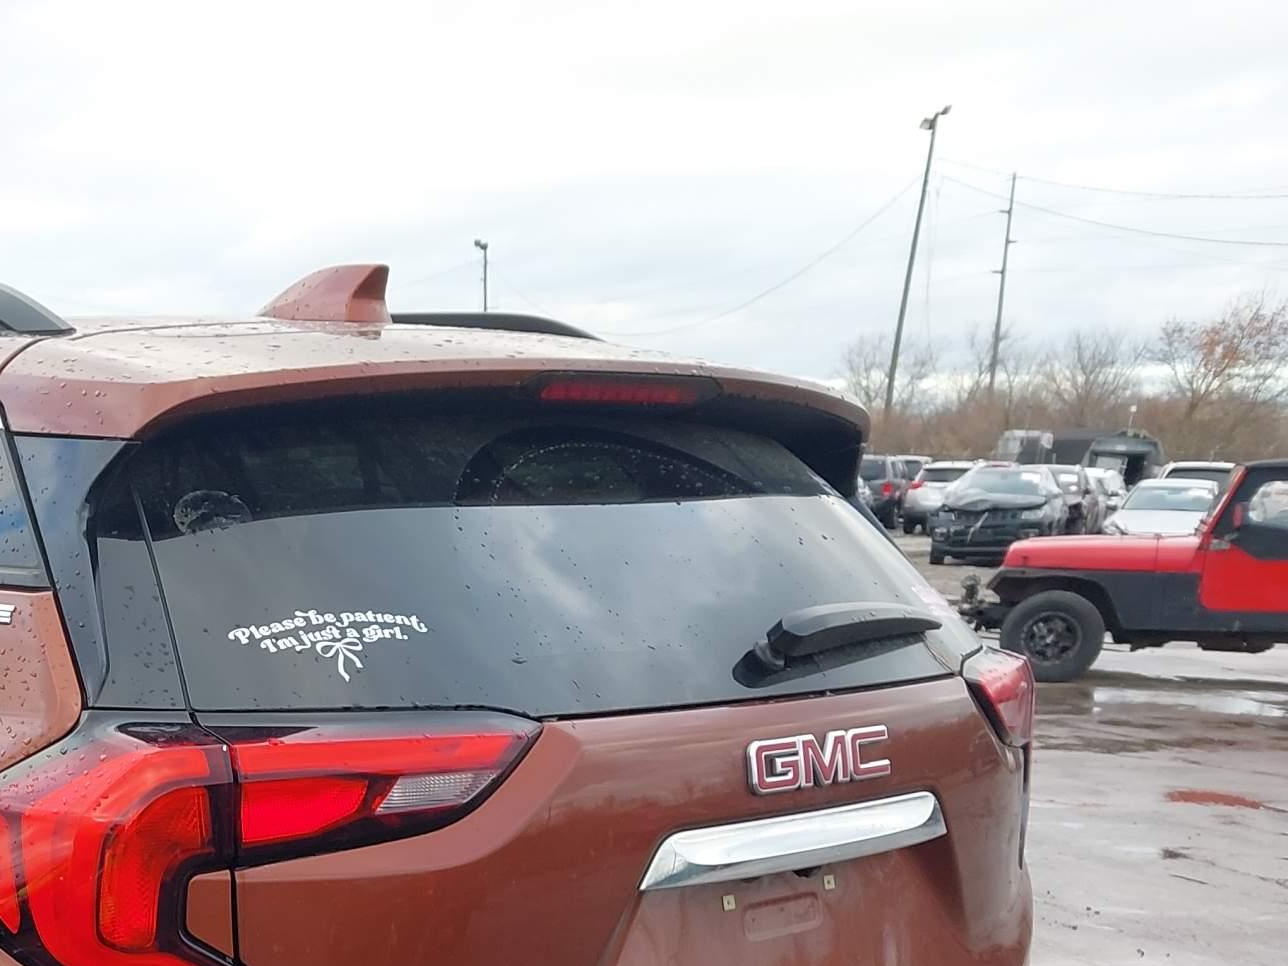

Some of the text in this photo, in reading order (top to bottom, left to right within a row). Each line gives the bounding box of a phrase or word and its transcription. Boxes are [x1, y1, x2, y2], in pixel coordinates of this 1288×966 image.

[228, 609, 428, 645] Please be patient
[260, 624, 409, 653] I'm just a girl.
[746, 724, 891, 796] GMC
